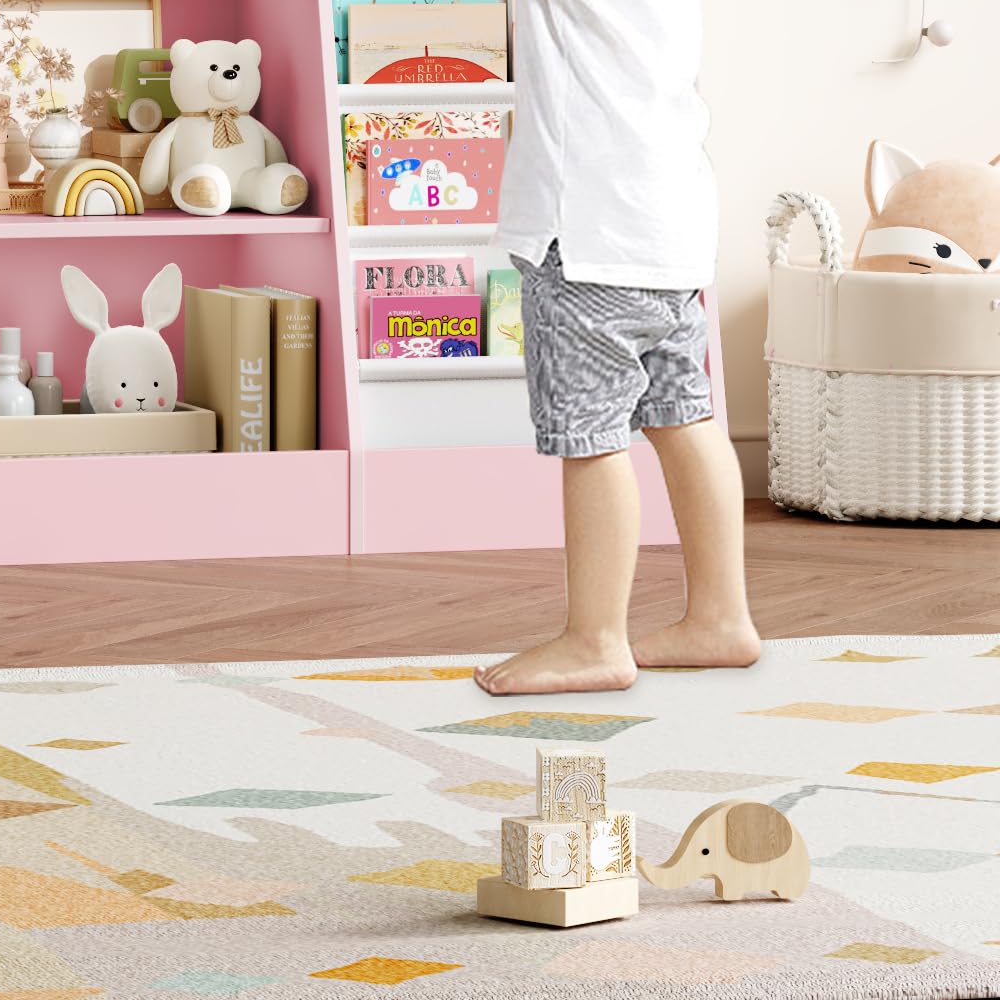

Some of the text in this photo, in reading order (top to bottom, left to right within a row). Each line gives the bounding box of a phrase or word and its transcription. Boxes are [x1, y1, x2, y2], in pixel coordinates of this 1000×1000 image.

[417, 64, 444, 74] RED
[394, 72, 467, 83] UMBRELLA
[364, 264, 471, 290] FLORA
